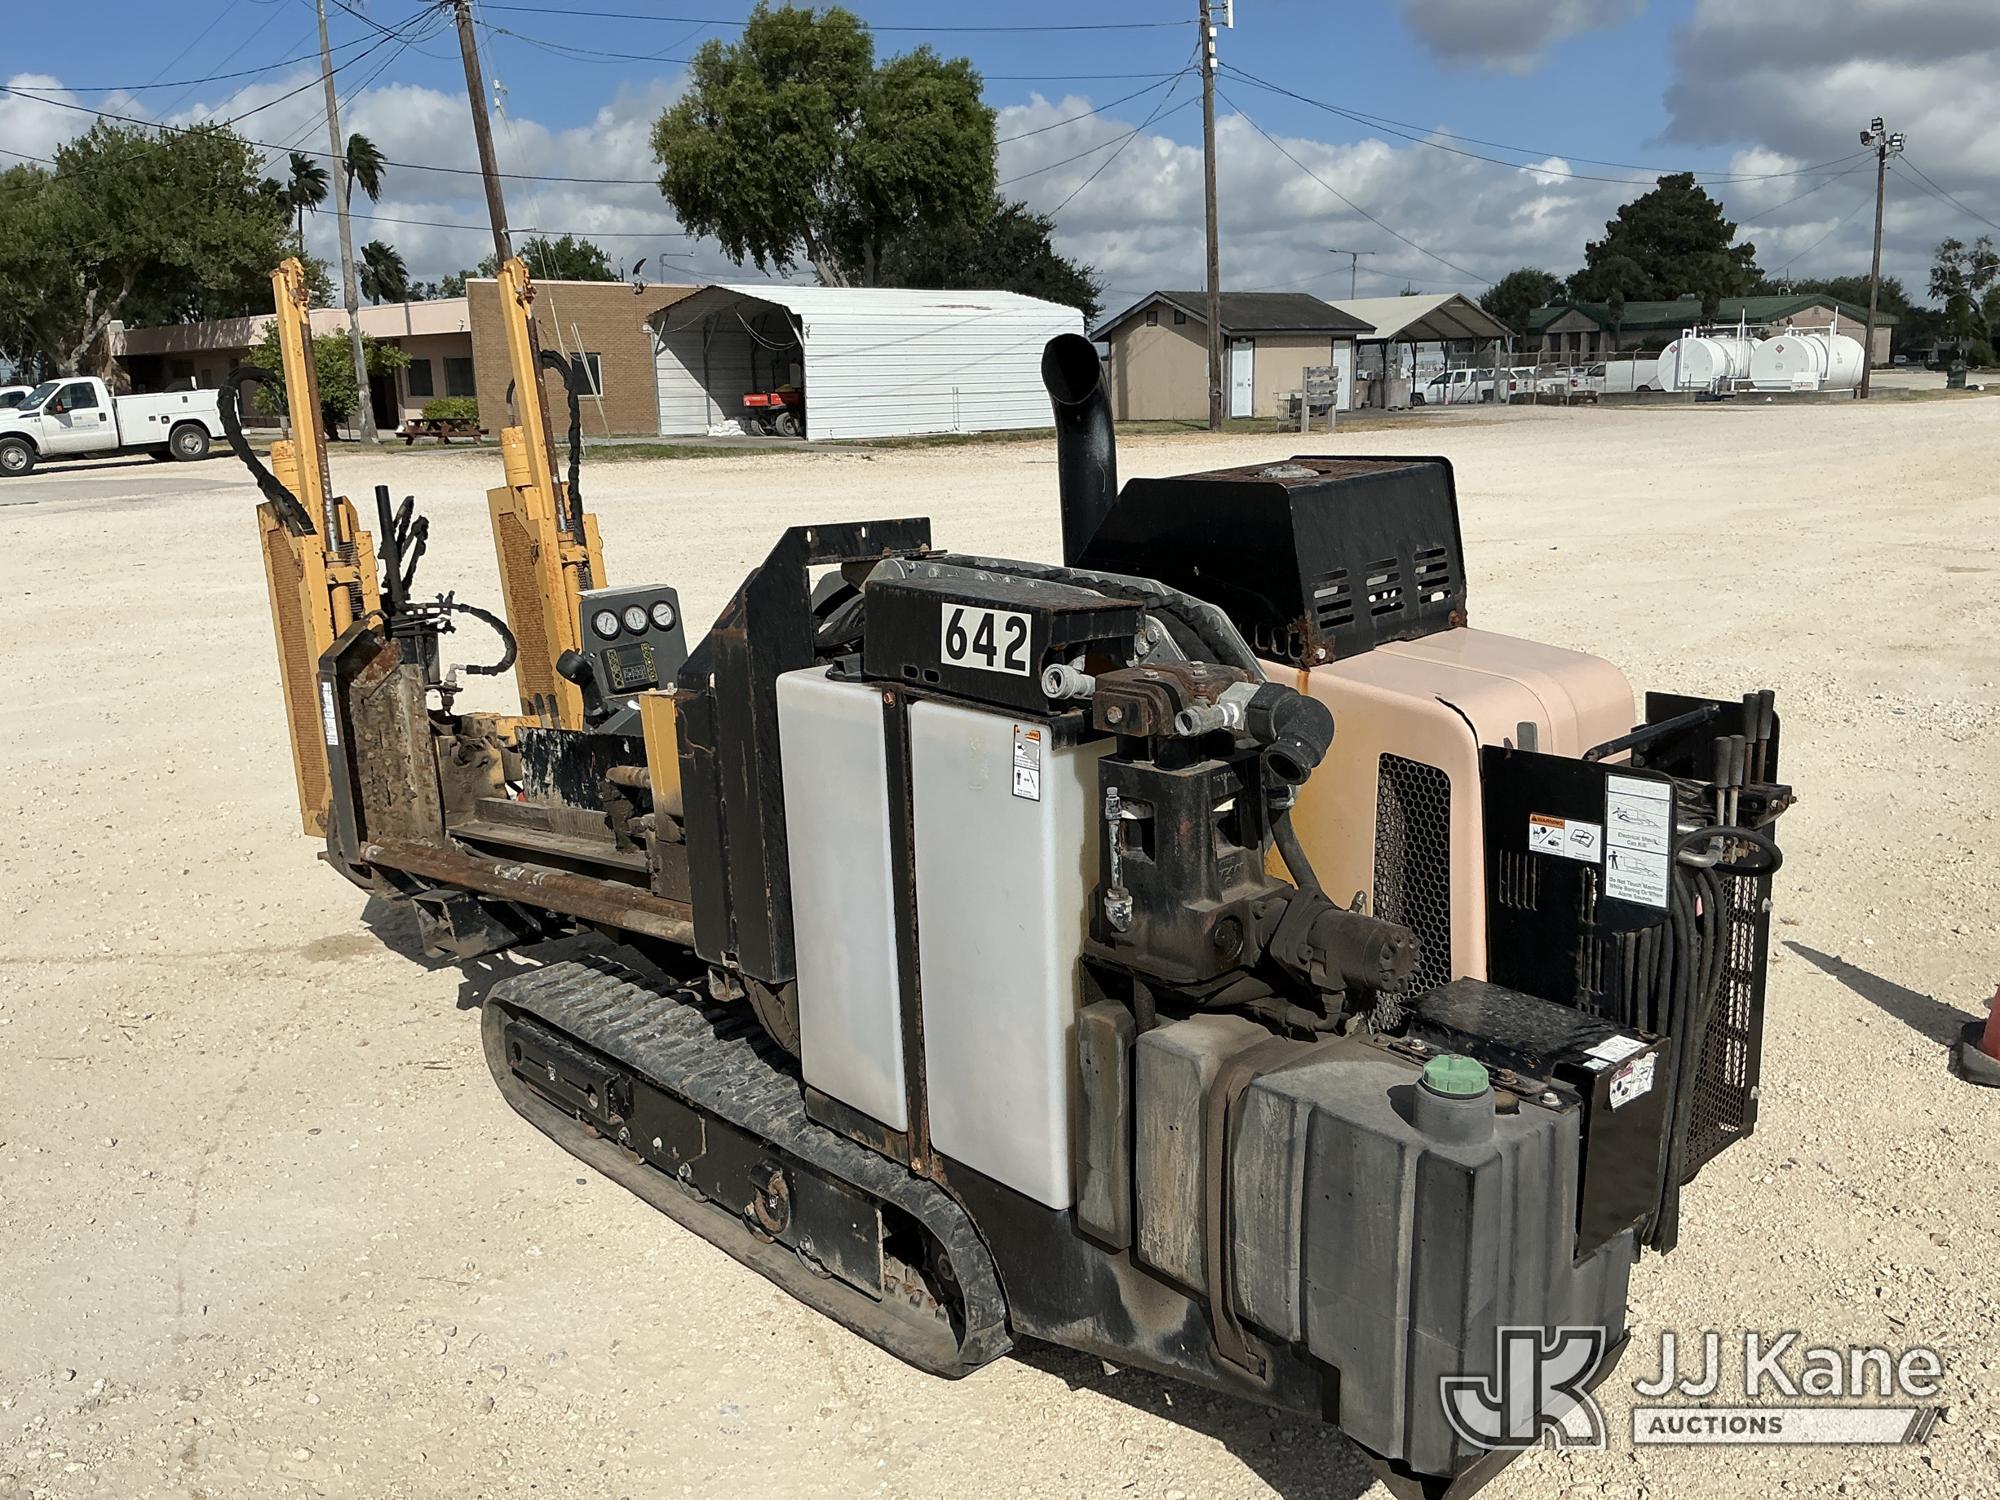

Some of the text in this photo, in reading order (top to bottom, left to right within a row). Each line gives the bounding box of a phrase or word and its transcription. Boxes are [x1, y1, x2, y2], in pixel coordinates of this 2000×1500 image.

[946, 608, 1027, 672] 642
[1537, 815, 1563, 826] WARNING
[1609, 883, 1623, 891] While
[1624, 886, 1640, 895] Boring
[1627, 880, 1642, 888] Touch
[1643, 883, 1663, 893] Machine
[1633, 894, 1653, 902] Sounds
